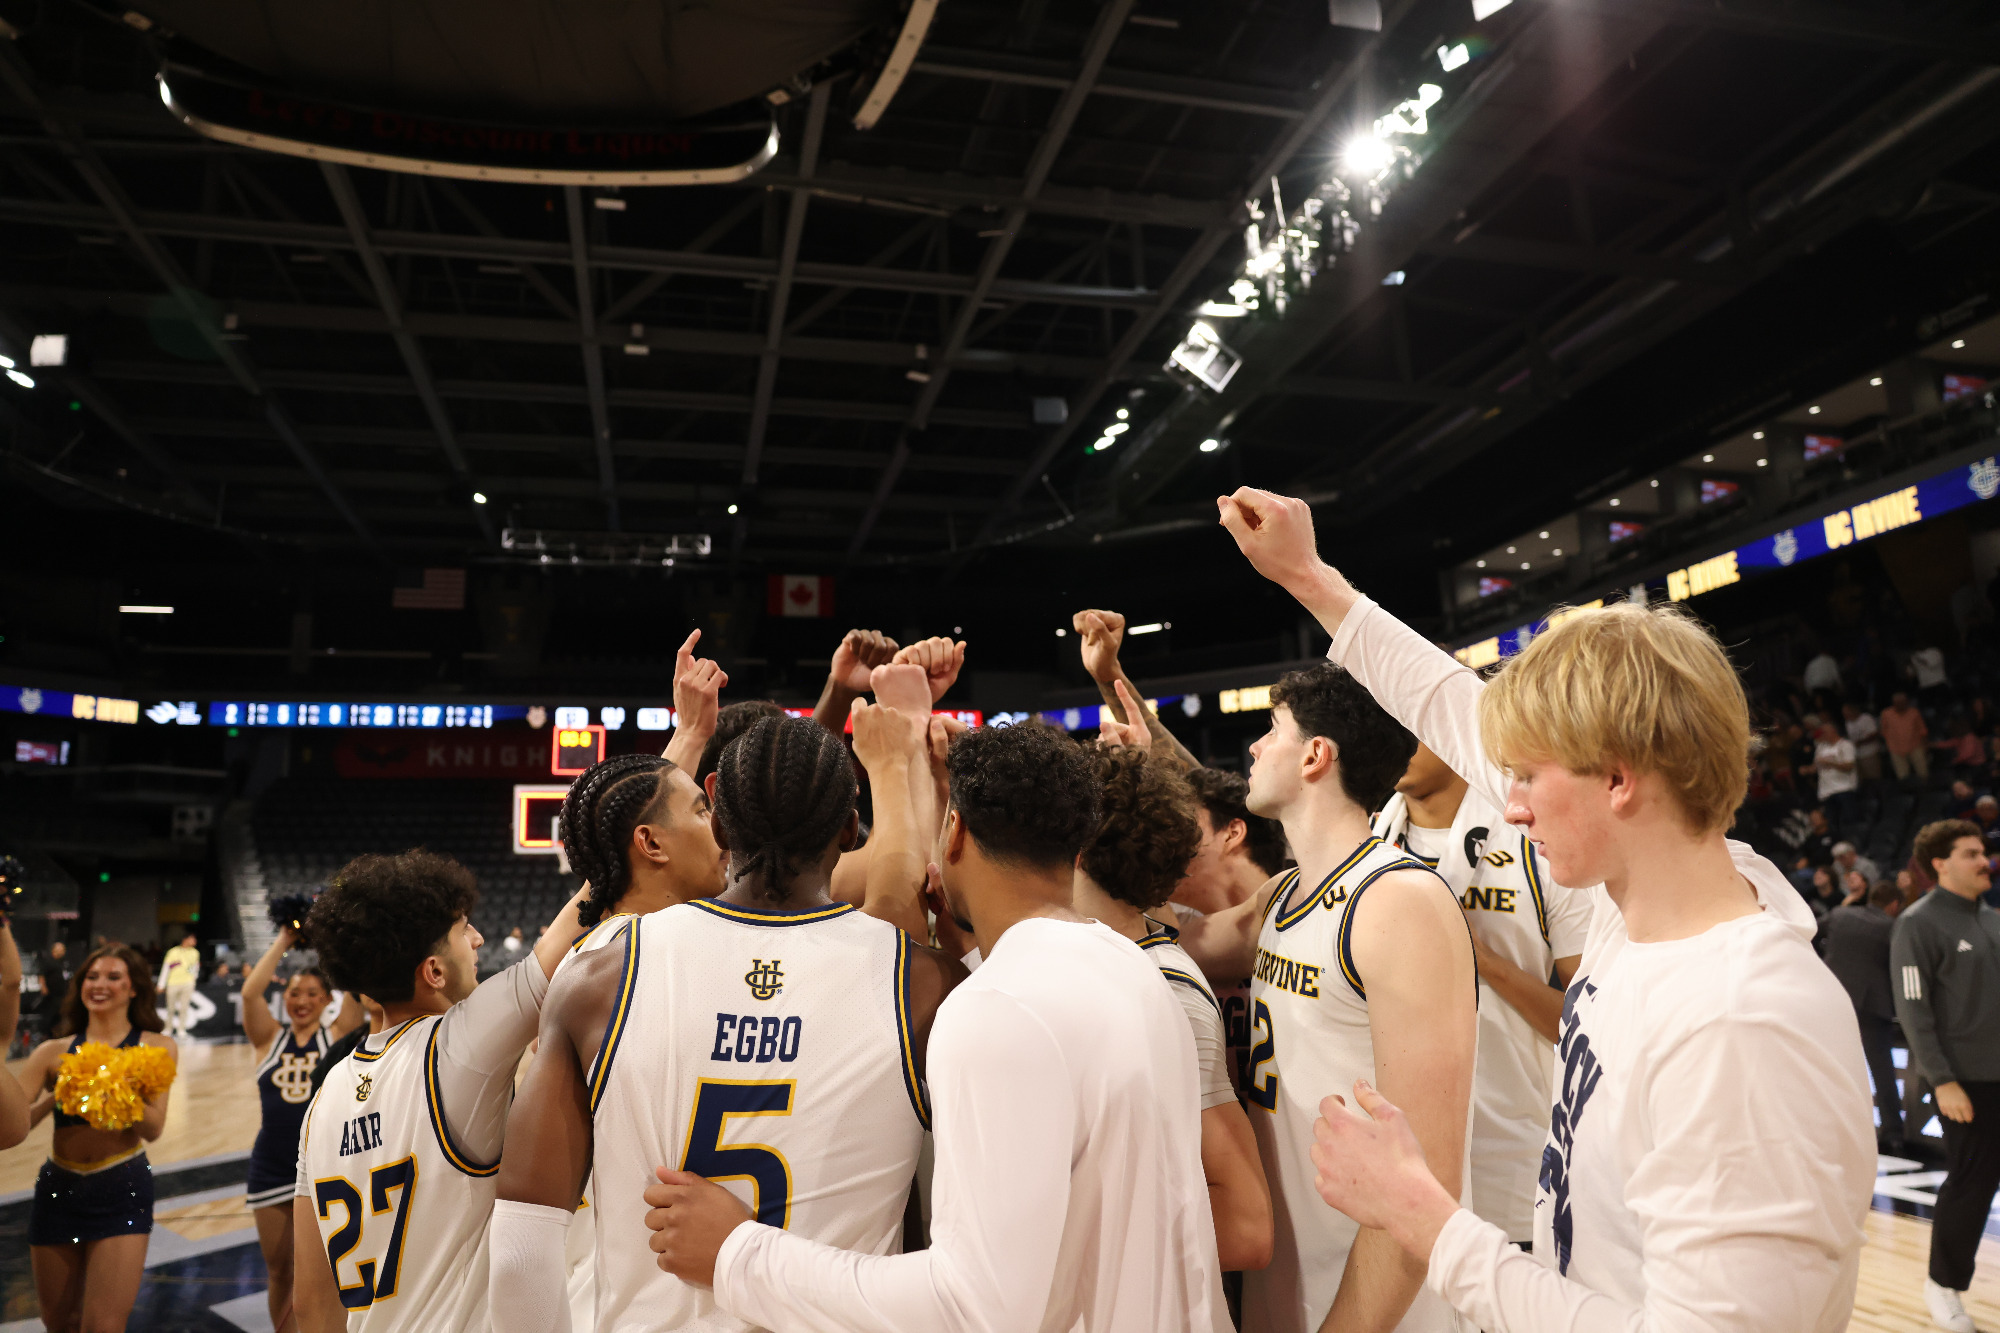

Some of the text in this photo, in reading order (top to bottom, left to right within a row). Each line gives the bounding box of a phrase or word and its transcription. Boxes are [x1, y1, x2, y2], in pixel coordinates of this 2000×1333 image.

[248, 88, 702, 160] Lee's Discount Liquor
[1824, 486, 1921, 549] UC IRVINE
[425, 746, 546, 768] KNIGH
[710, 1012, 803, 1064] EGBO
[339, 1111, 383, 1157] AHIR
[678, 1076, 798, 1238] 5
[314, 1151, 420, 1312] 27
